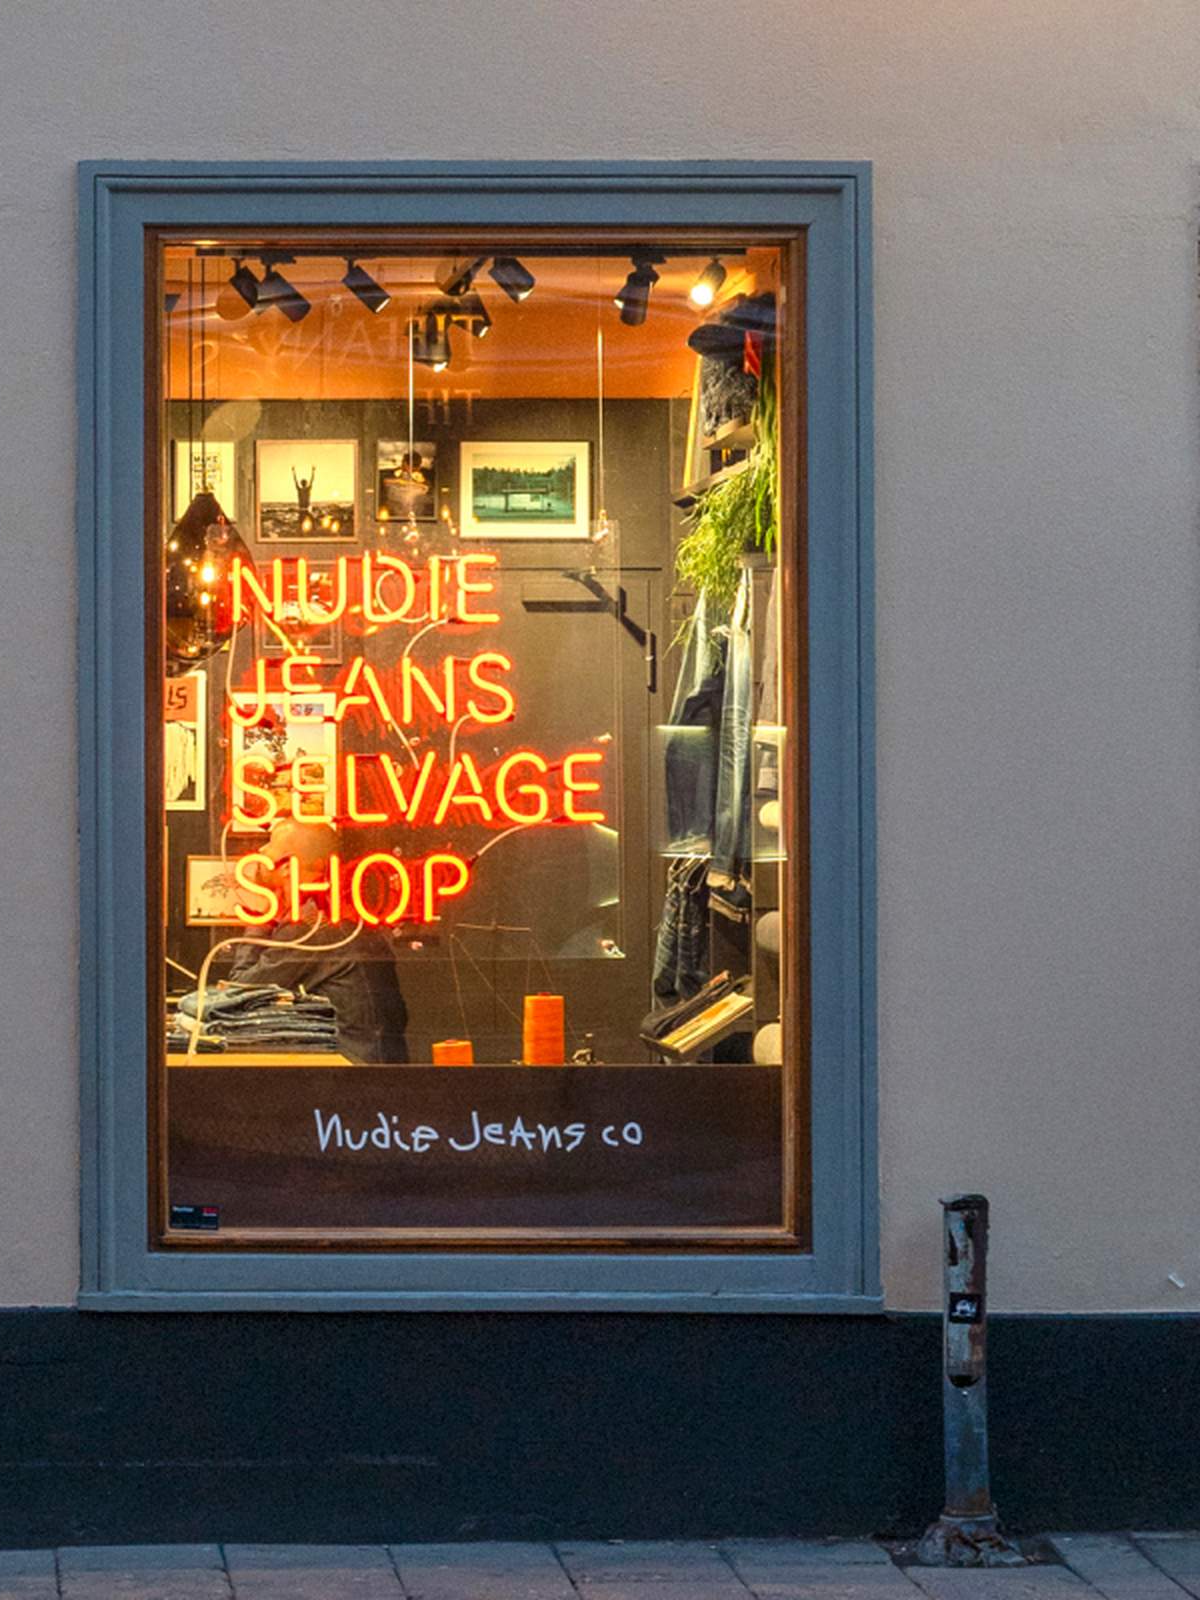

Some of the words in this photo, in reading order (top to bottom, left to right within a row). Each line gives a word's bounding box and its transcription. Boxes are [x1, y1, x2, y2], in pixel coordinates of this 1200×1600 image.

[231, 555, 501, 624] NUDIE
[227, 652, 516, 725] JEANS
[231, 752, 605, 827] SELVAGE
[231, 851, 470, 926] SHOP
